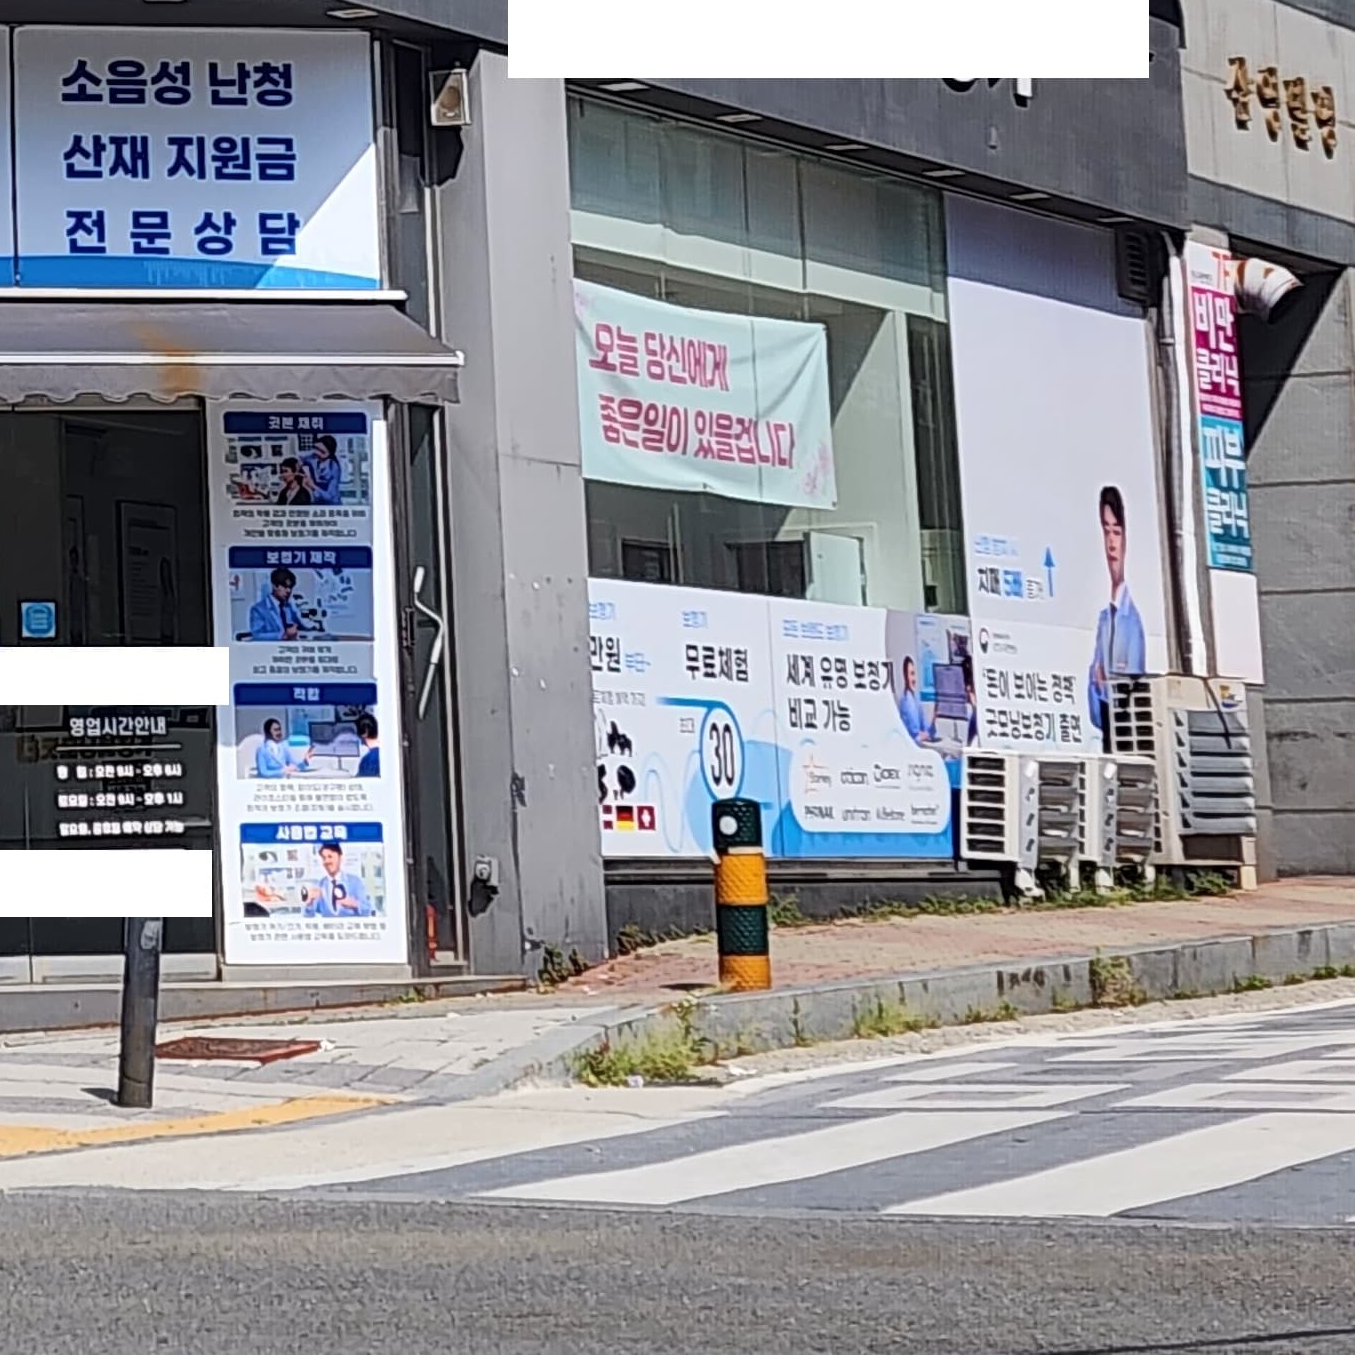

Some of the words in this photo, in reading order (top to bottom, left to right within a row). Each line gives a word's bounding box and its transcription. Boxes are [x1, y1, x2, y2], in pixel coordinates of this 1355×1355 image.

[61, 59, 192, 105] 소음성
[208, 63, 294, 107] 난청
[63, 135, 150, 180] 산재
[167, 136, 297, 182] 지원금
[589, 322, 640, 378] 오늘
[644, 331, 730, 392] 당신에게
[1197, 348, 1241, 396] 클리닉
[685, 644, 749, 683] 무료체험
[787, 653, 816, 687] 세계
[820, 656, 848, 690] 유명
[853, 659, 895, 693] 보청기
[69, 716, 167, 736] 영업시간안내
[788, 697, 818, 730] 비교
[822, 699, 851, 732] 가능
[710, 722, 736, 786] 30
